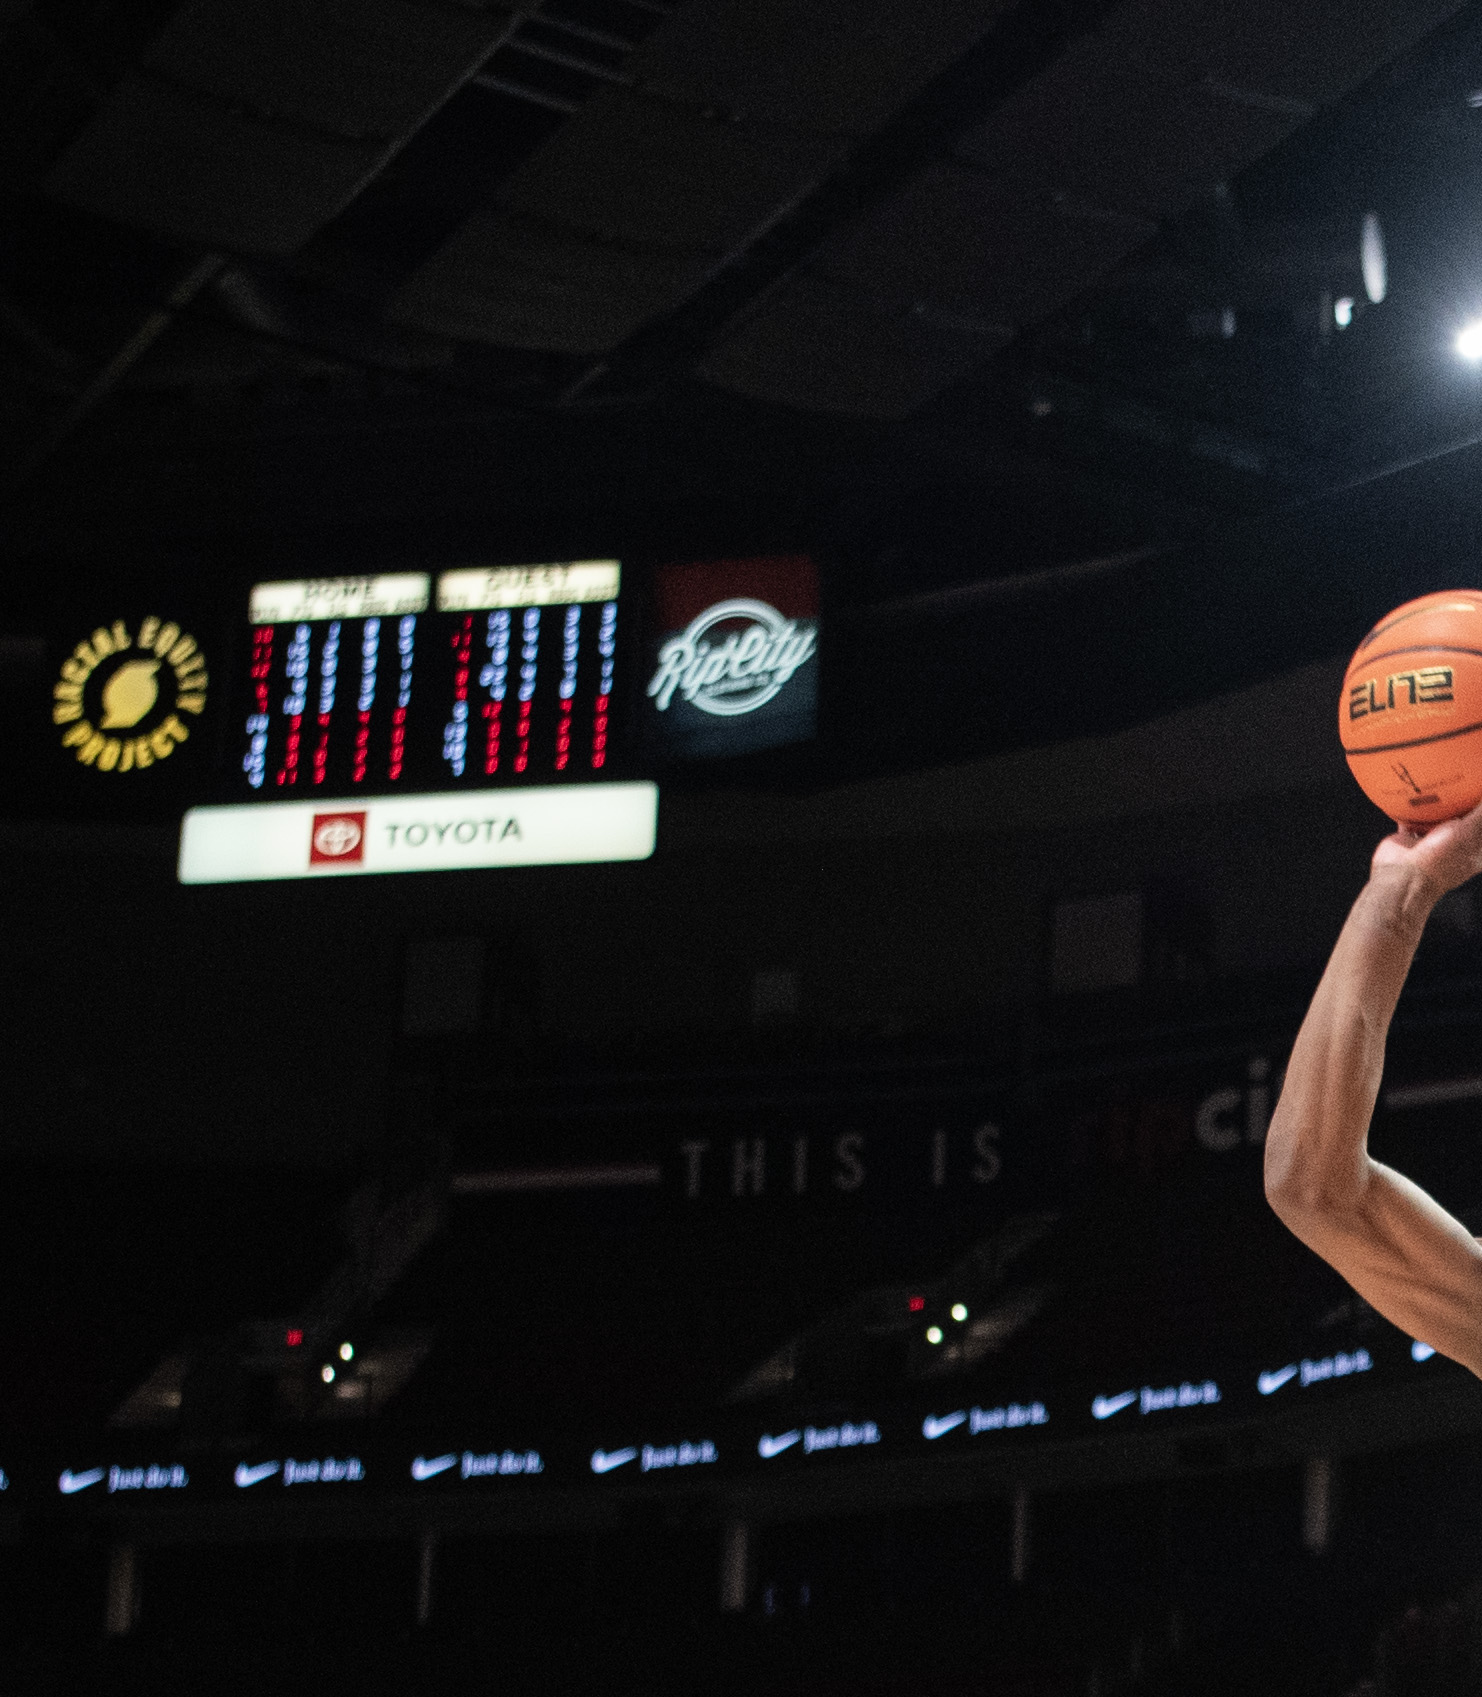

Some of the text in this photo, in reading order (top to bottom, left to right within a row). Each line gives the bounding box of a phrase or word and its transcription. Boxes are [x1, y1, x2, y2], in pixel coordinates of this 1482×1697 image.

[384, 816, 524, 849] TOYOTA
[681, 1131, 866, 1198] THIS
[930, 1121, 1001, 1188] IS
